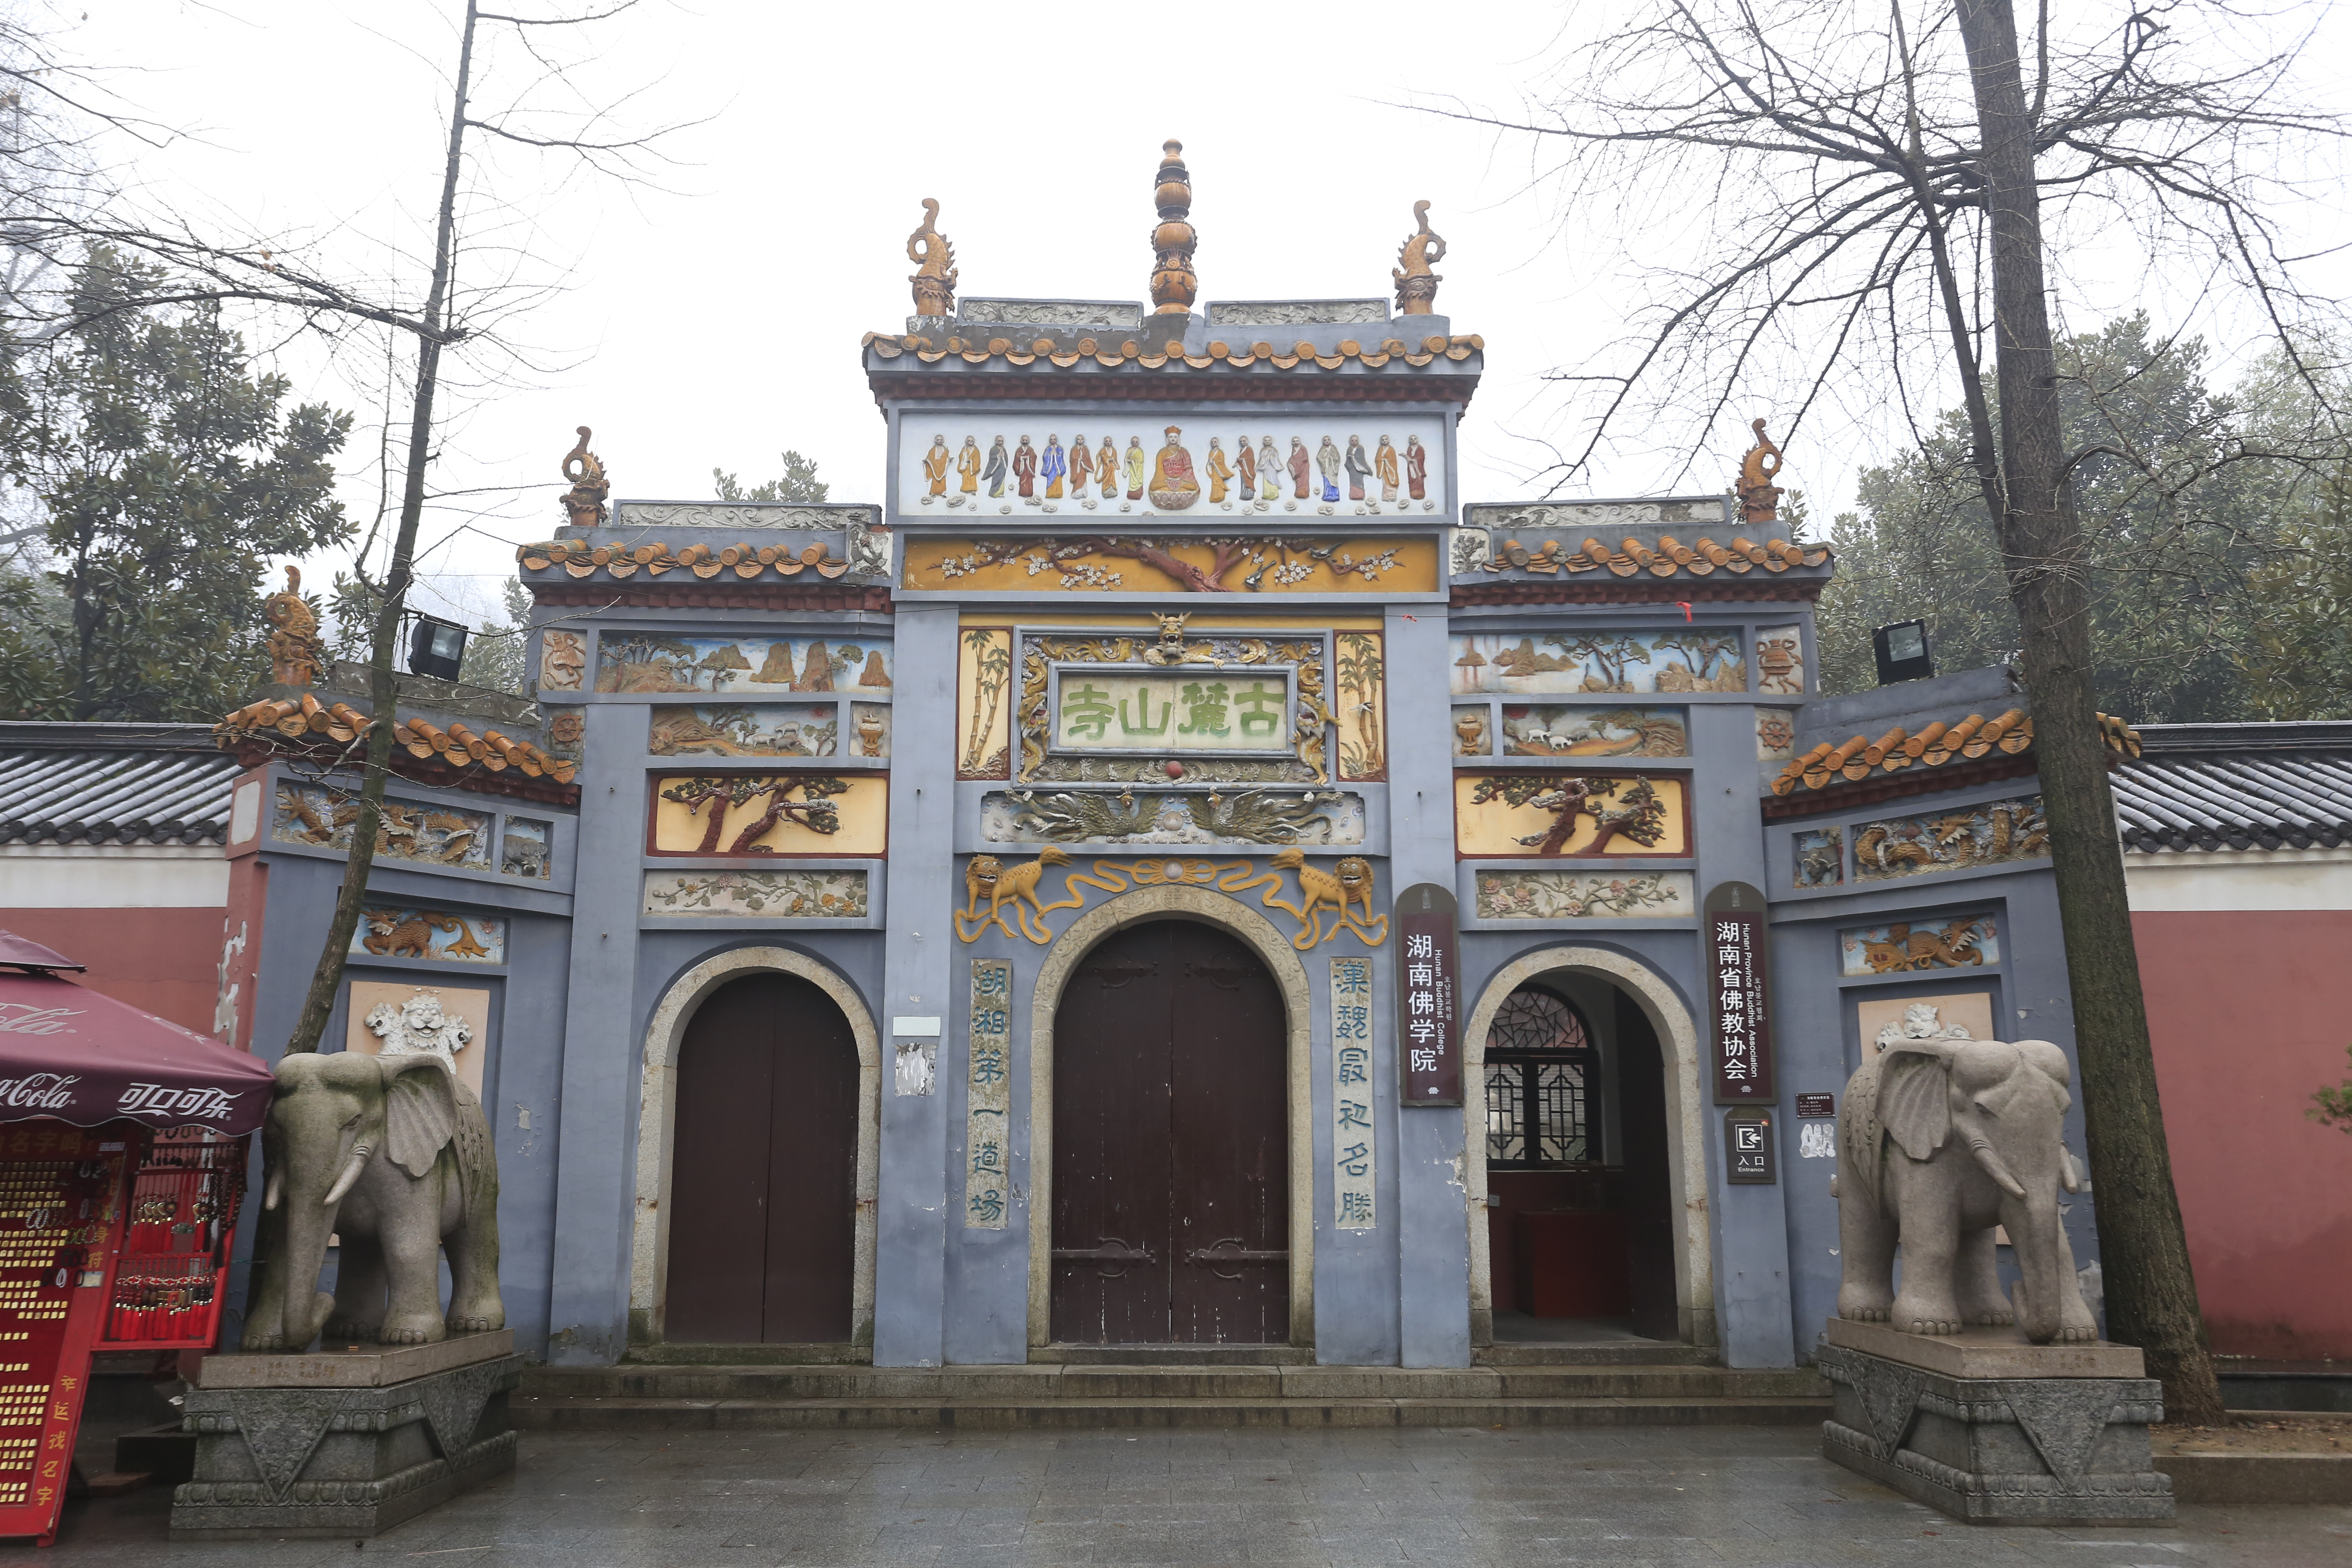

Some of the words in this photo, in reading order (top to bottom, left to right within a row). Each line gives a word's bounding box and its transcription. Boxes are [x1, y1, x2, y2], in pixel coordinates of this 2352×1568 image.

[1744, 952, 1753, 988] Province
[1407, 934, 1437, 1072] 湖南佛学院
[1436, 981, 1444, 1018] Buddhist
[1717, 922, 1748, 1080] 湖南省佛教协会
[1746, 991, 1755, 1027] Buddhist
[1436, 1022, 1445, 1055] College
[1749, 1030, 1758, 1077] Association
[117, 1082, 244, 1118] 可口可乐
[1738, 1156, 1764, 1166] 入口
